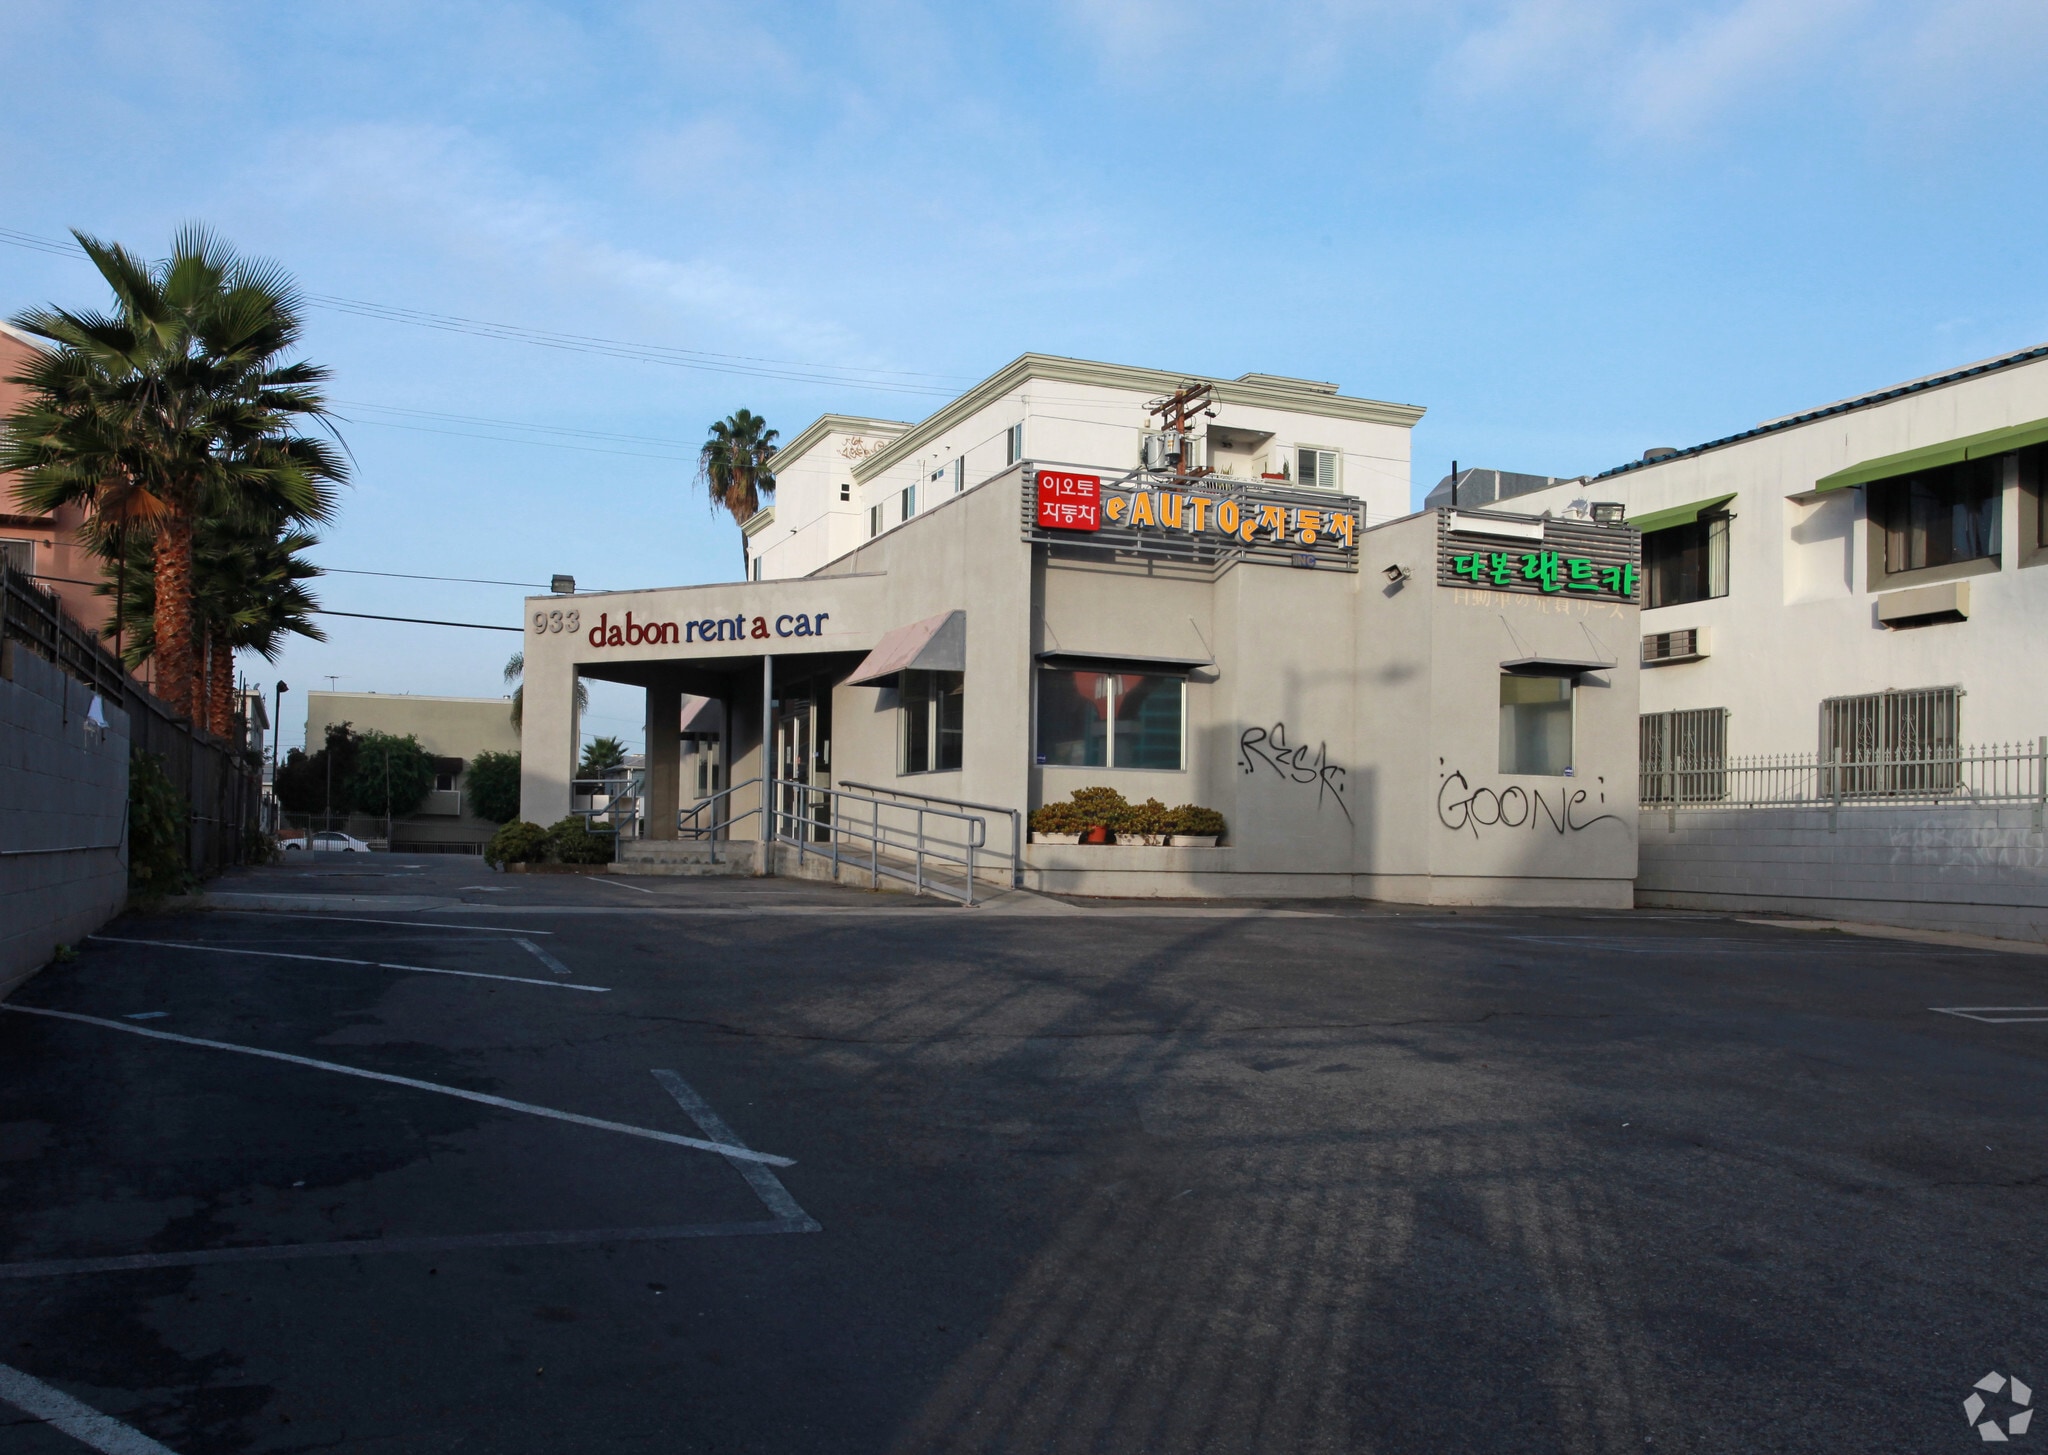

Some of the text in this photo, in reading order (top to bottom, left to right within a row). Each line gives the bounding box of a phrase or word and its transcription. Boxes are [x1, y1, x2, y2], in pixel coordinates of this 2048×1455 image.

[1042, 476, 1093, 497] 이오토
[1042, 502, 1096, 525] 자동차
[533, 610, 580, 634] 933
[589, 612, 829, 647] dabon rent a car
